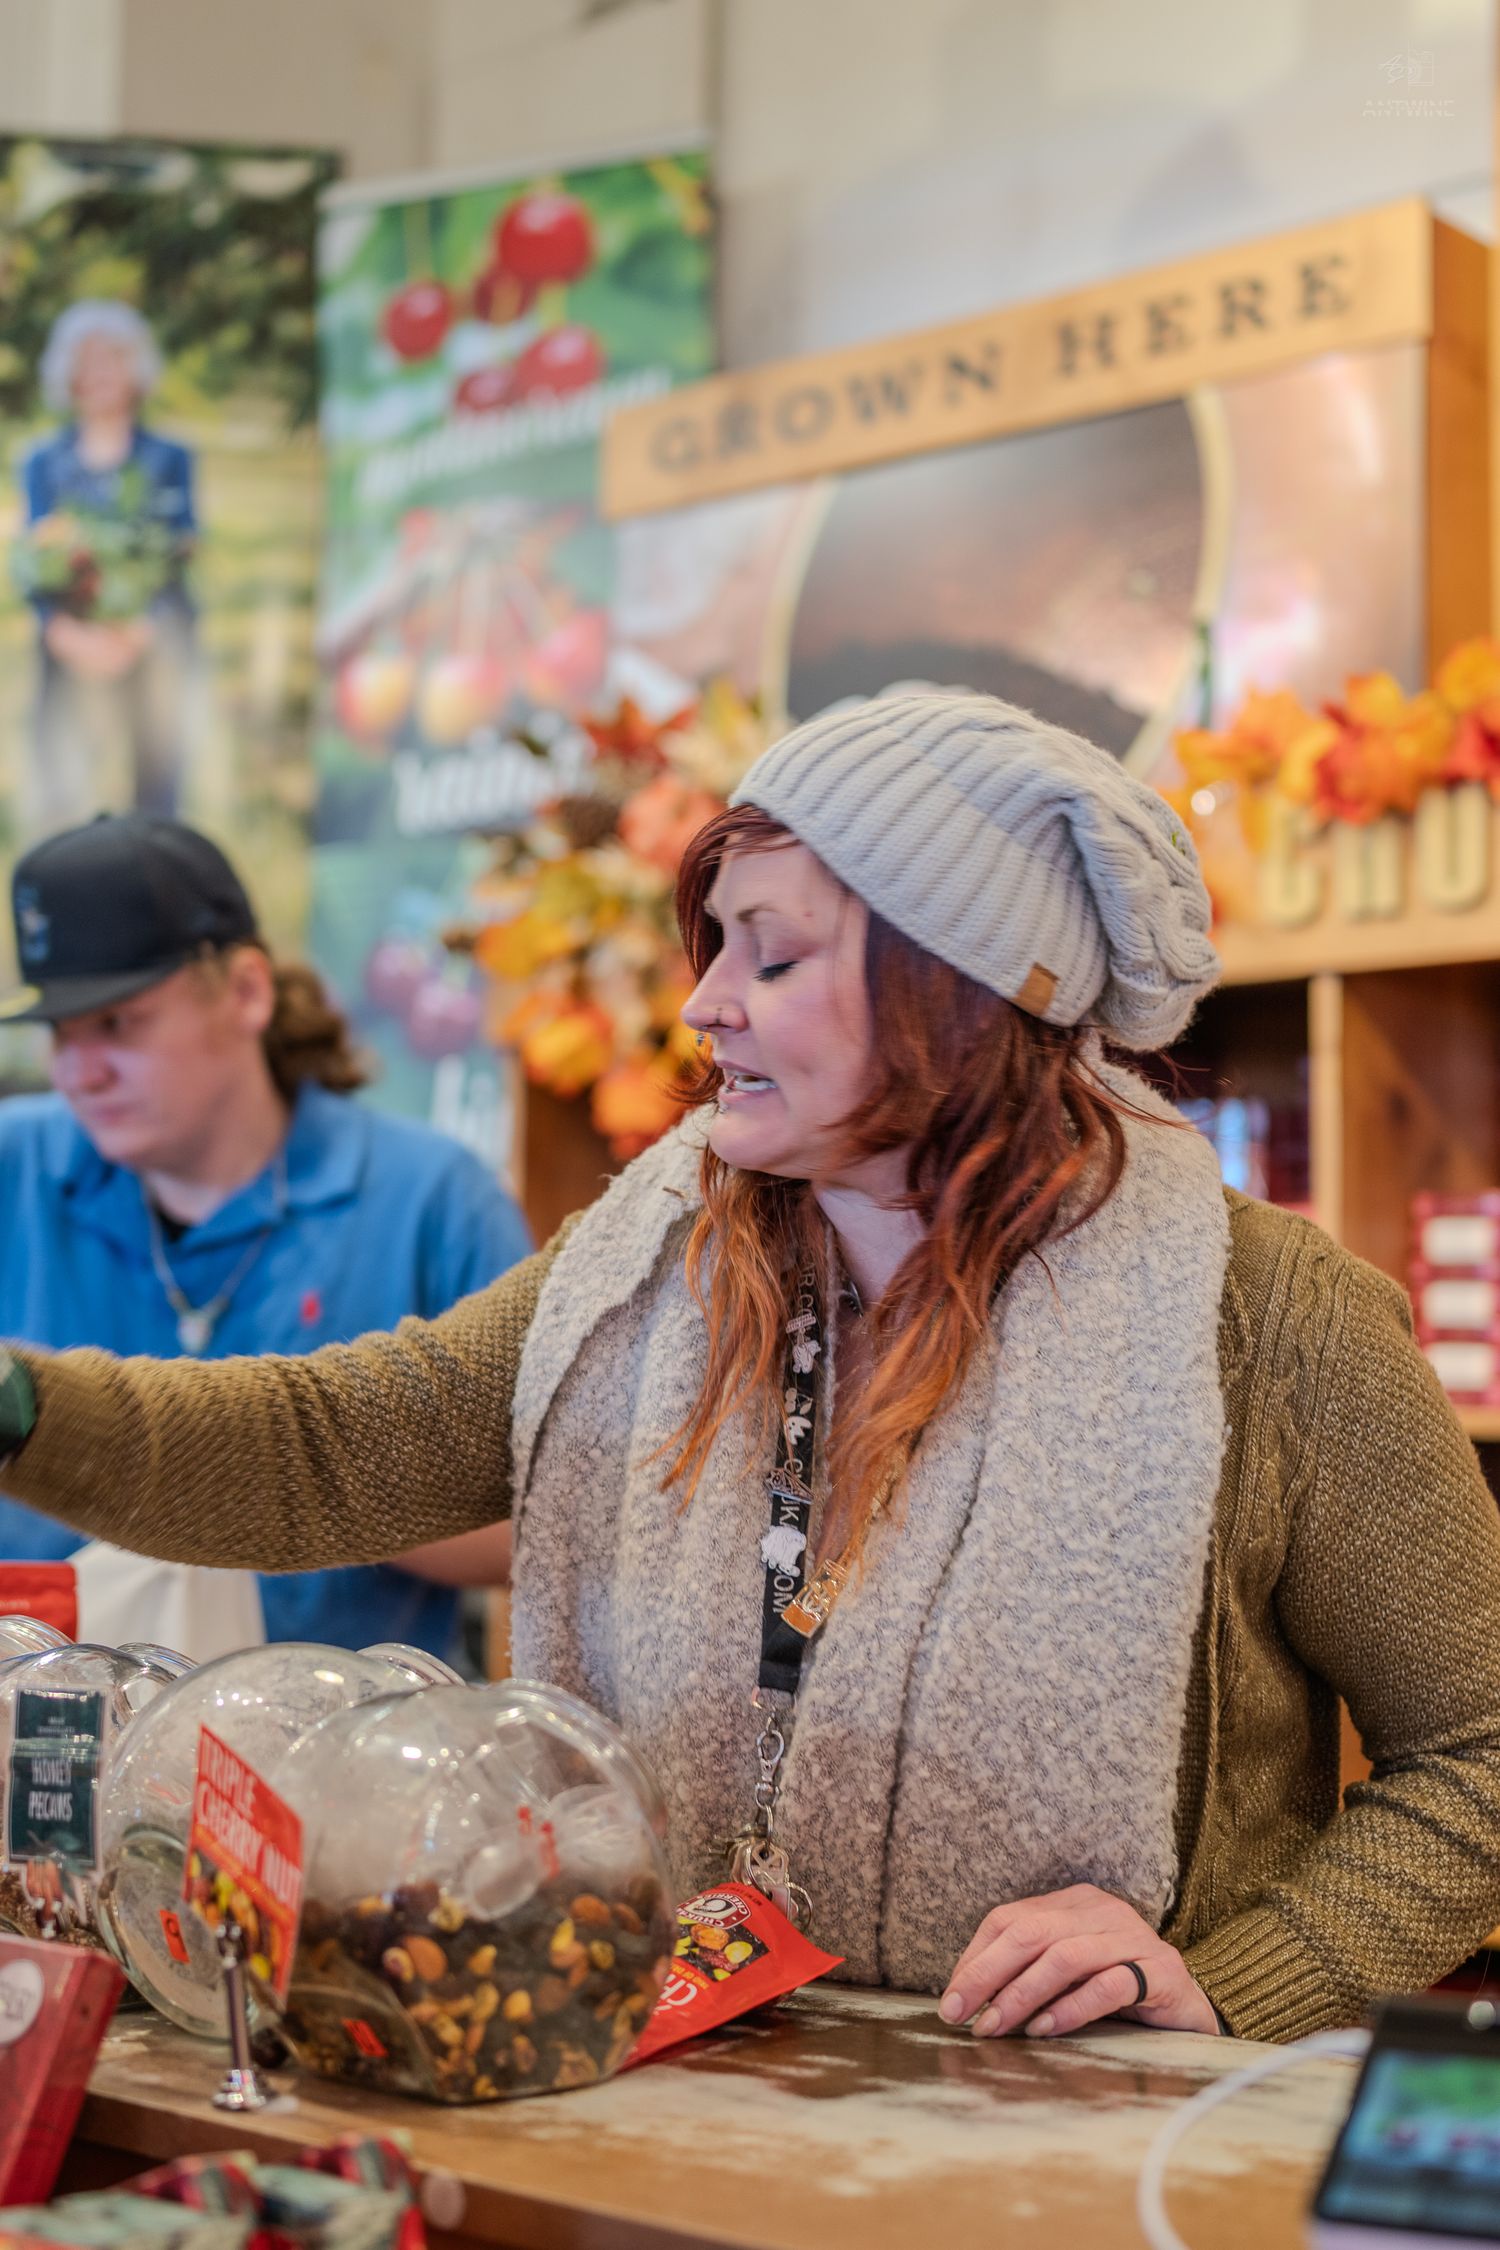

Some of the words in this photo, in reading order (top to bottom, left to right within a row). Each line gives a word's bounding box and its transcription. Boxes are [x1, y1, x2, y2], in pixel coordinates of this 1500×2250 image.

[649, 340, 1006, 477] GROWN
[1054, 252, 1352, 378] HERE
[28, 1790, 74, 1822] PECANS
[31, 1757, 73, 1787] HONEY
[200, 1730, 257, 1822] TRIPLE
[197, 1780, 265, 1876] CHERRY
[259, 1842, 303, 1910] NUT
